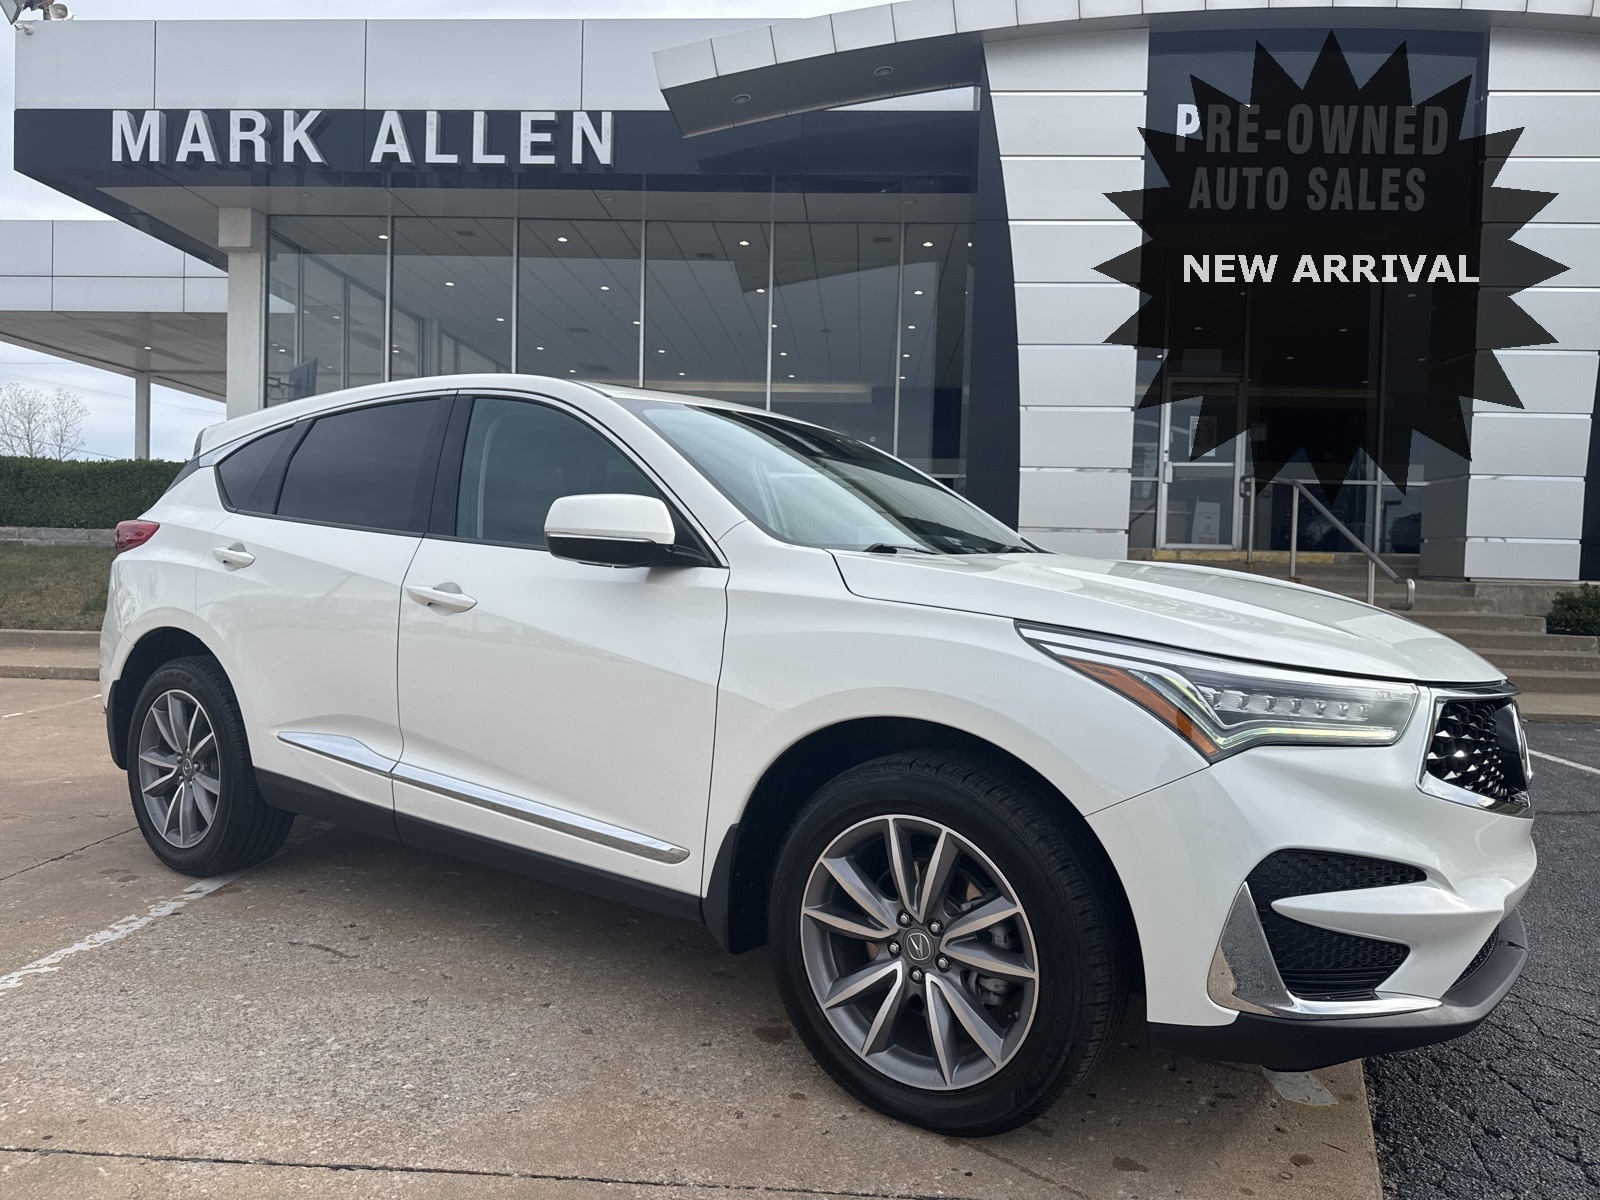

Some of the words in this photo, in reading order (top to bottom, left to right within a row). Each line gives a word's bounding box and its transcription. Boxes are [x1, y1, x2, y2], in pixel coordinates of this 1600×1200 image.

[111, 110, 326, 164] MARK
[370, 110, 615, 166] ALLEN
[1175, 103, 1449, 155] PRE-OWNED
[1188, 166, 1289, 211] AUTO
[1306, 166, 1426, 212] SALES
